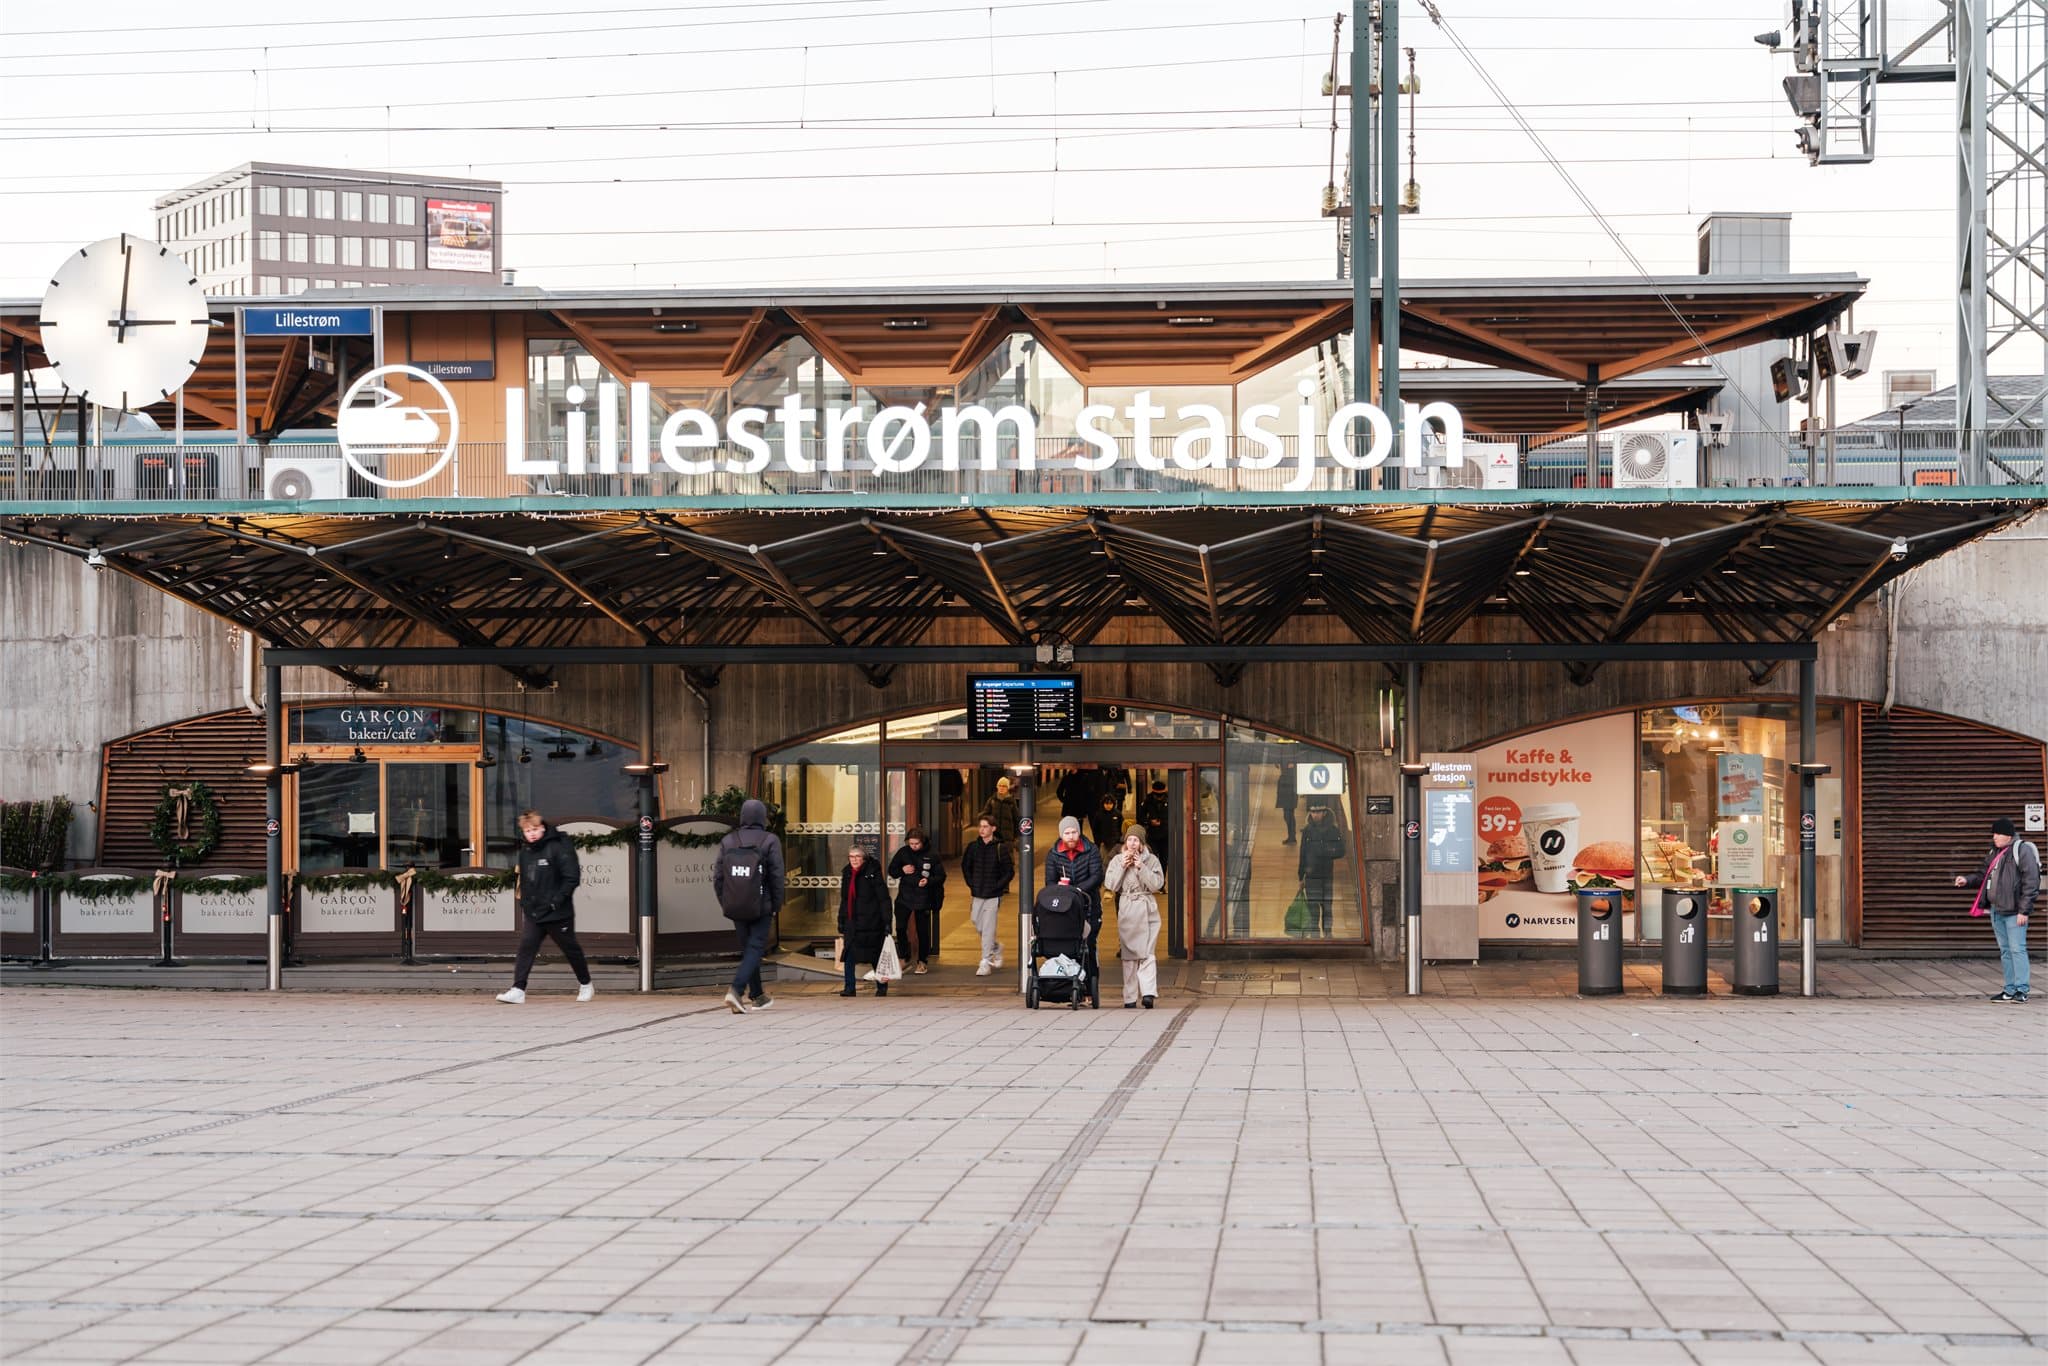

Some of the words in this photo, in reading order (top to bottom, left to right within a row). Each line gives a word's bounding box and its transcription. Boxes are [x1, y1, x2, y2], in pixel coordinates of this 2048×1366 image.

[275, 313, 341, 327] Lillestrøm
[428, 365, 472, 375] Lillestrøm
[506, 382, 1036, 477] Lillestrøm
[1074, 378, 1464, 492] stasjon
[340, 710, 424, 725] GARÇON
[1109, 705, 1118, 719] 8
[349, 727, 416, 740] bakeri/café
[1506, 749, 1555, 764] Kaffe
[1559, 749, 1573, 764] &
[1313, 770, 1326, 784] N
[1432, 772, 1466, 784] stasjon
[1487, 768, 1592, 786] rundstykke
[732, 866, 750, 877] HH
[200, 896, 255, 906] GARÇON
[320, 895, 377, 906] GARÇON
[441, 894, 497, 905] GARÇON
[442, 906, 496, 915] bakeri/afé
[1523, 917, 1576, 925] NARVESEN
